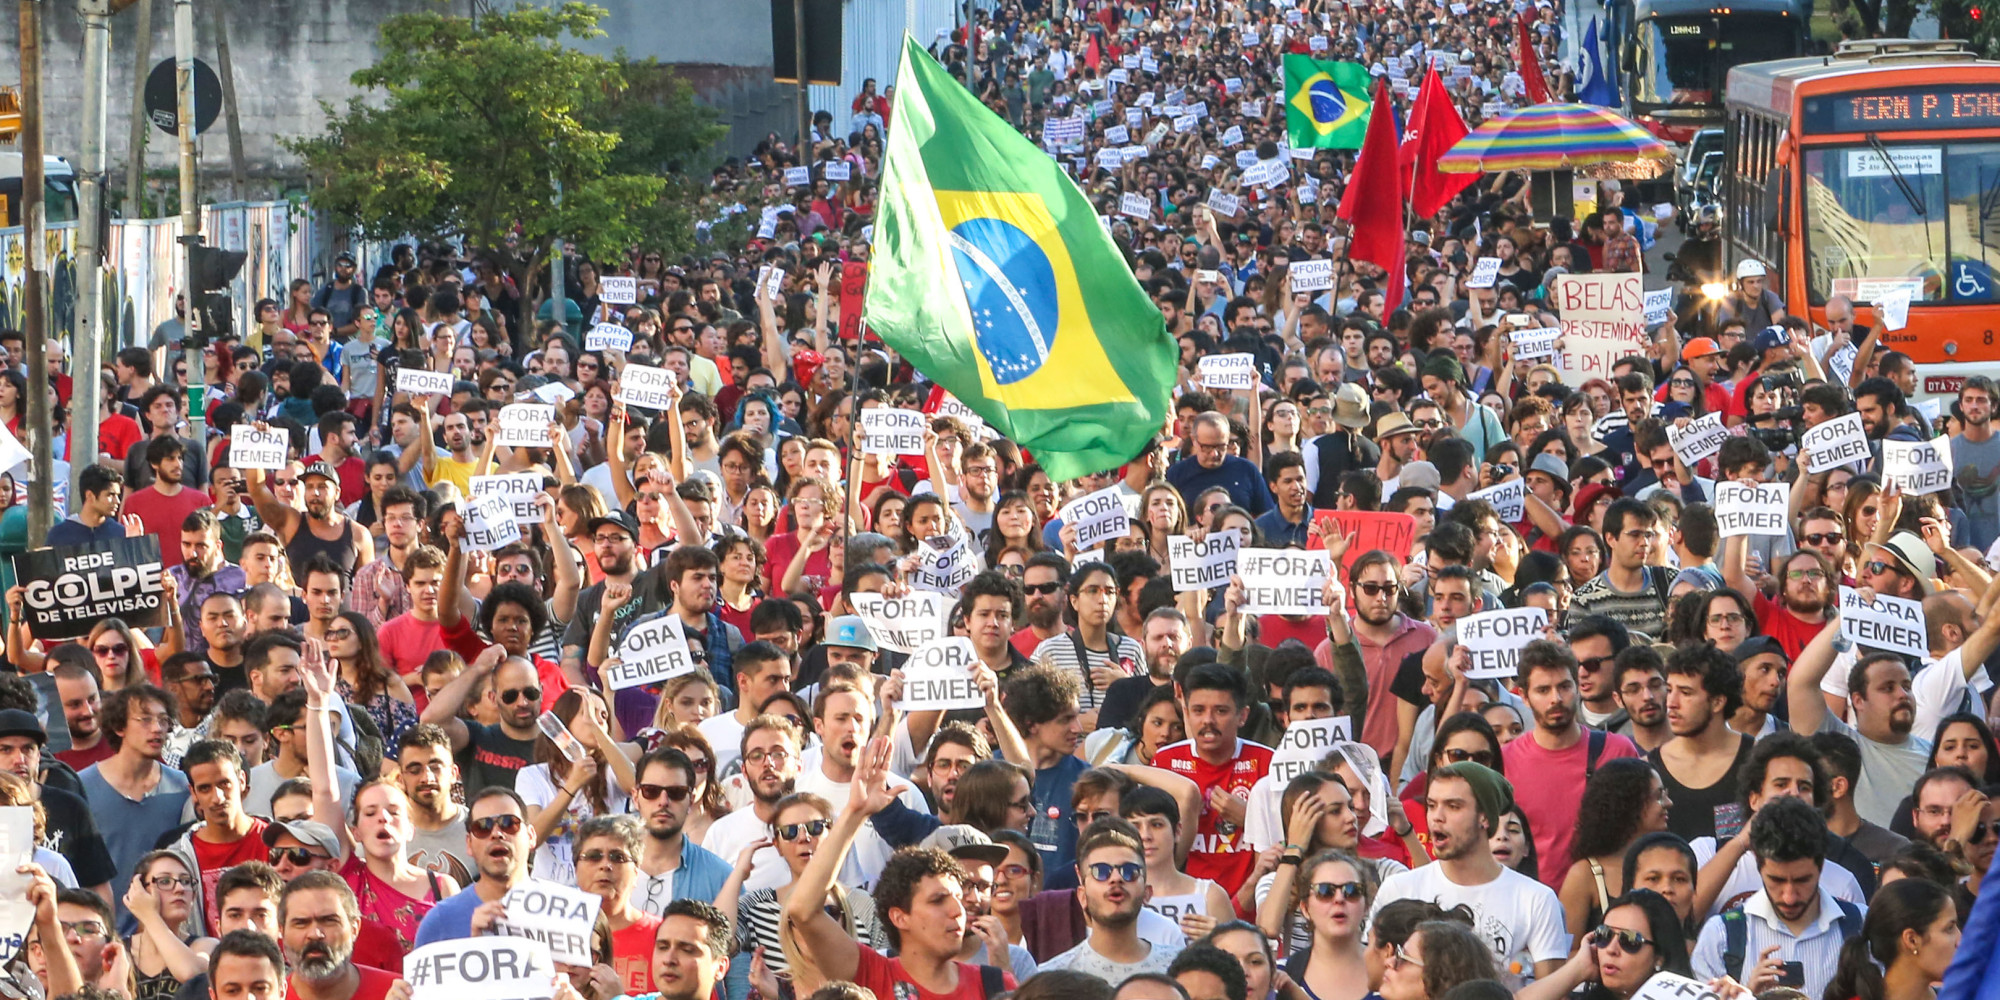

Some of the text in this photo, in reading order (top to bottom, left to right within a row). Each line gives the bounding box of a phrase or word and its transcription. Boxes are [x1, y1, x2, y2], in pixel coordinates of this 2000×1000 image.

[1851, 96, 1910, 119] TERM
[1922, 94, 1940, 118] P.
[1858, 155, 1866, 171] VIA
[1209, 199, 1234, 214] TEMER
[1212, 189, 1237, 204] #FORA
[1124, 204, 1148, 217] TEMER
[1293, 262, 1329, 274] #FORA
[1294, 277, 1331, 289] TEMER
[602, 292, 634, 300] TEMER
[1563, 278, 1644, 313] BELAS,
[1561, 318, 1645, 344] DESTEMIDAS
[1882, 333, 1917, 342] Baixo
[588, 337, 628, 347] TEMER
[1202, 357, 1249, 368] #FORA
[1563, 353, 1573, 370] E
[1582, 354, 1601, 373] DA
[400, 374, 449, 390] #FORA
[1201, 373, 1249, 385] TEMER
[1928, 381, 1946, 390] DTA
[617, 389, 669, 405] TEMER
[865, 414, 921, 428] #FORA
[1671, 418, 1718, 443] #FORA
[235, 430, 284, 445] #FORA
[499, 428, 550, 442] TEMER
[865, 435, 921, 450] TEMER
[1804, 419, 1860, 447] #FORA
[1678, 431, 1729, 459] TEMER
[1809, 441, 1865, 468] TEMER
[233, 450, 283, 464] TEMER
[474, 479, 538, 495] #FORA
[1718, 488, 1784, 505] #FORA
[460, 494, 509, 522] #FORA
[1066, 492, 1123, 523] #FORA
[1077, 516, 1126, 543] EMER
[1718, 512, 1783, 530] TEMER
[464, 519, 517, 546] TEMER
[1376, 520, 1413, 552] TEM
[921, 544, 966, 569] #FORA
[1173, 535, 1236, 558] #FORA
[64, 551, 115, 572] REDE
[1244, 557, 1326, 577] #FORA
[913, 565, 971, 587] TEMER
[1174, 560, 1237, 584] TEMER
[25, 562, 164, 609] GOLPE
[1243, 587, 1323, 606] TEMER
[38, 593, 160, 624] DE TELEVISÃO
[860, 600, 935, 617] #FORA
[1463, 614, 1545, 638] #FORA
[1843, 617, 1922, 649] TEMER
[872, 625, 935, 648] TEMER
[610, 651, 684, 681] TEMER
[1468, 649, 1518, 670] TEM
[1272, 761, 1315, 782] TEM
[1190, 833, 1252, 854] AIXA
